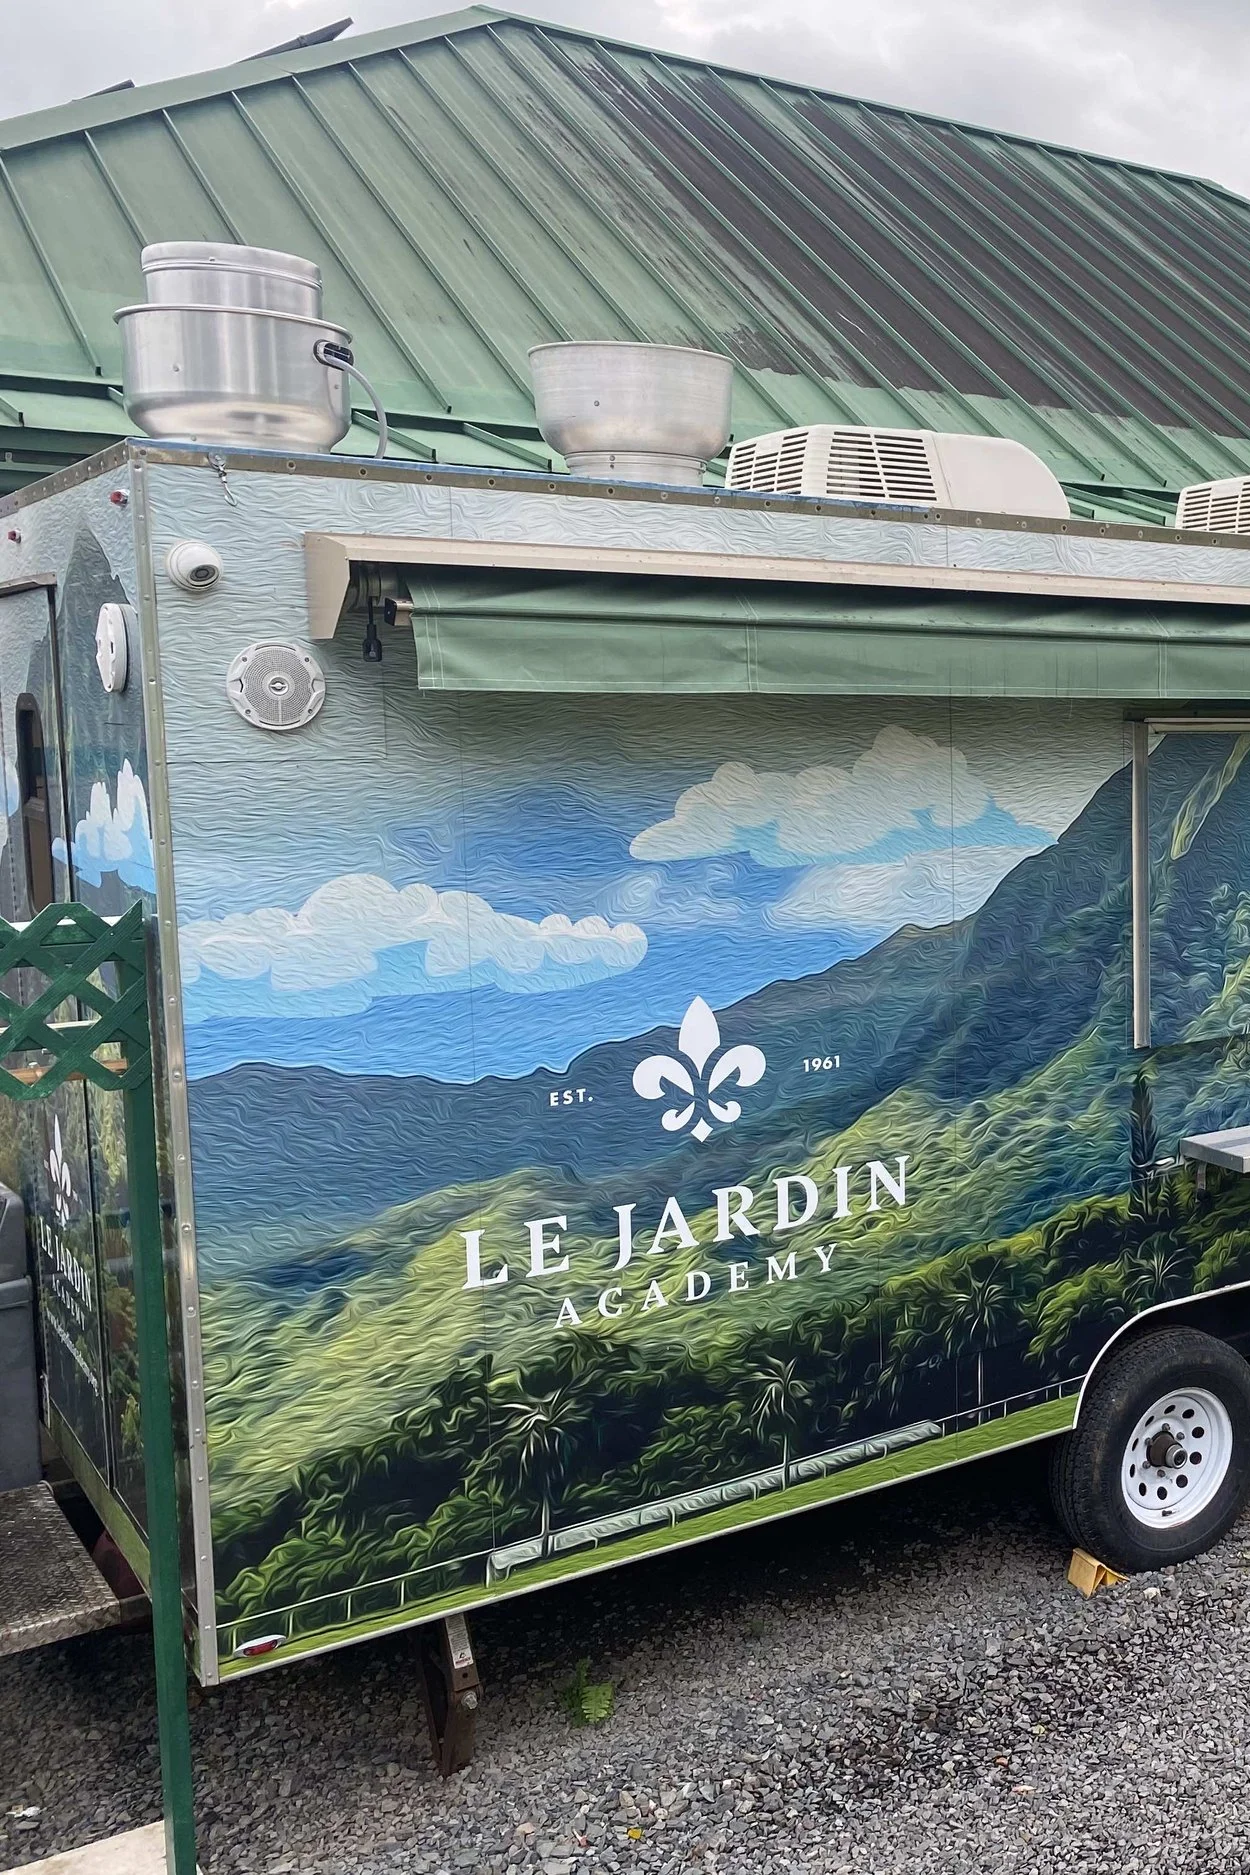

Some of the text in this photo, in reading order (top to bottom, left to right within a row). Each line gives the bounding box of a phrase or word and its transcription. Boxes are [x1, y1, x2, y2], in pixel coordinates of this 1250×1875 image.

[550, 1088, 594, 1106] EST.
[803, 1055, 841, 1073] 1961
[459, 1155, 912, 1291] LE JARDIN
[39, 1216, 54, 1259] LE
[55, 1234, 92, 1312] JARDIN
[552, 1243, 838, 1330] ACADEMY
[52, 1273, 85, 1331] ACADEMY
